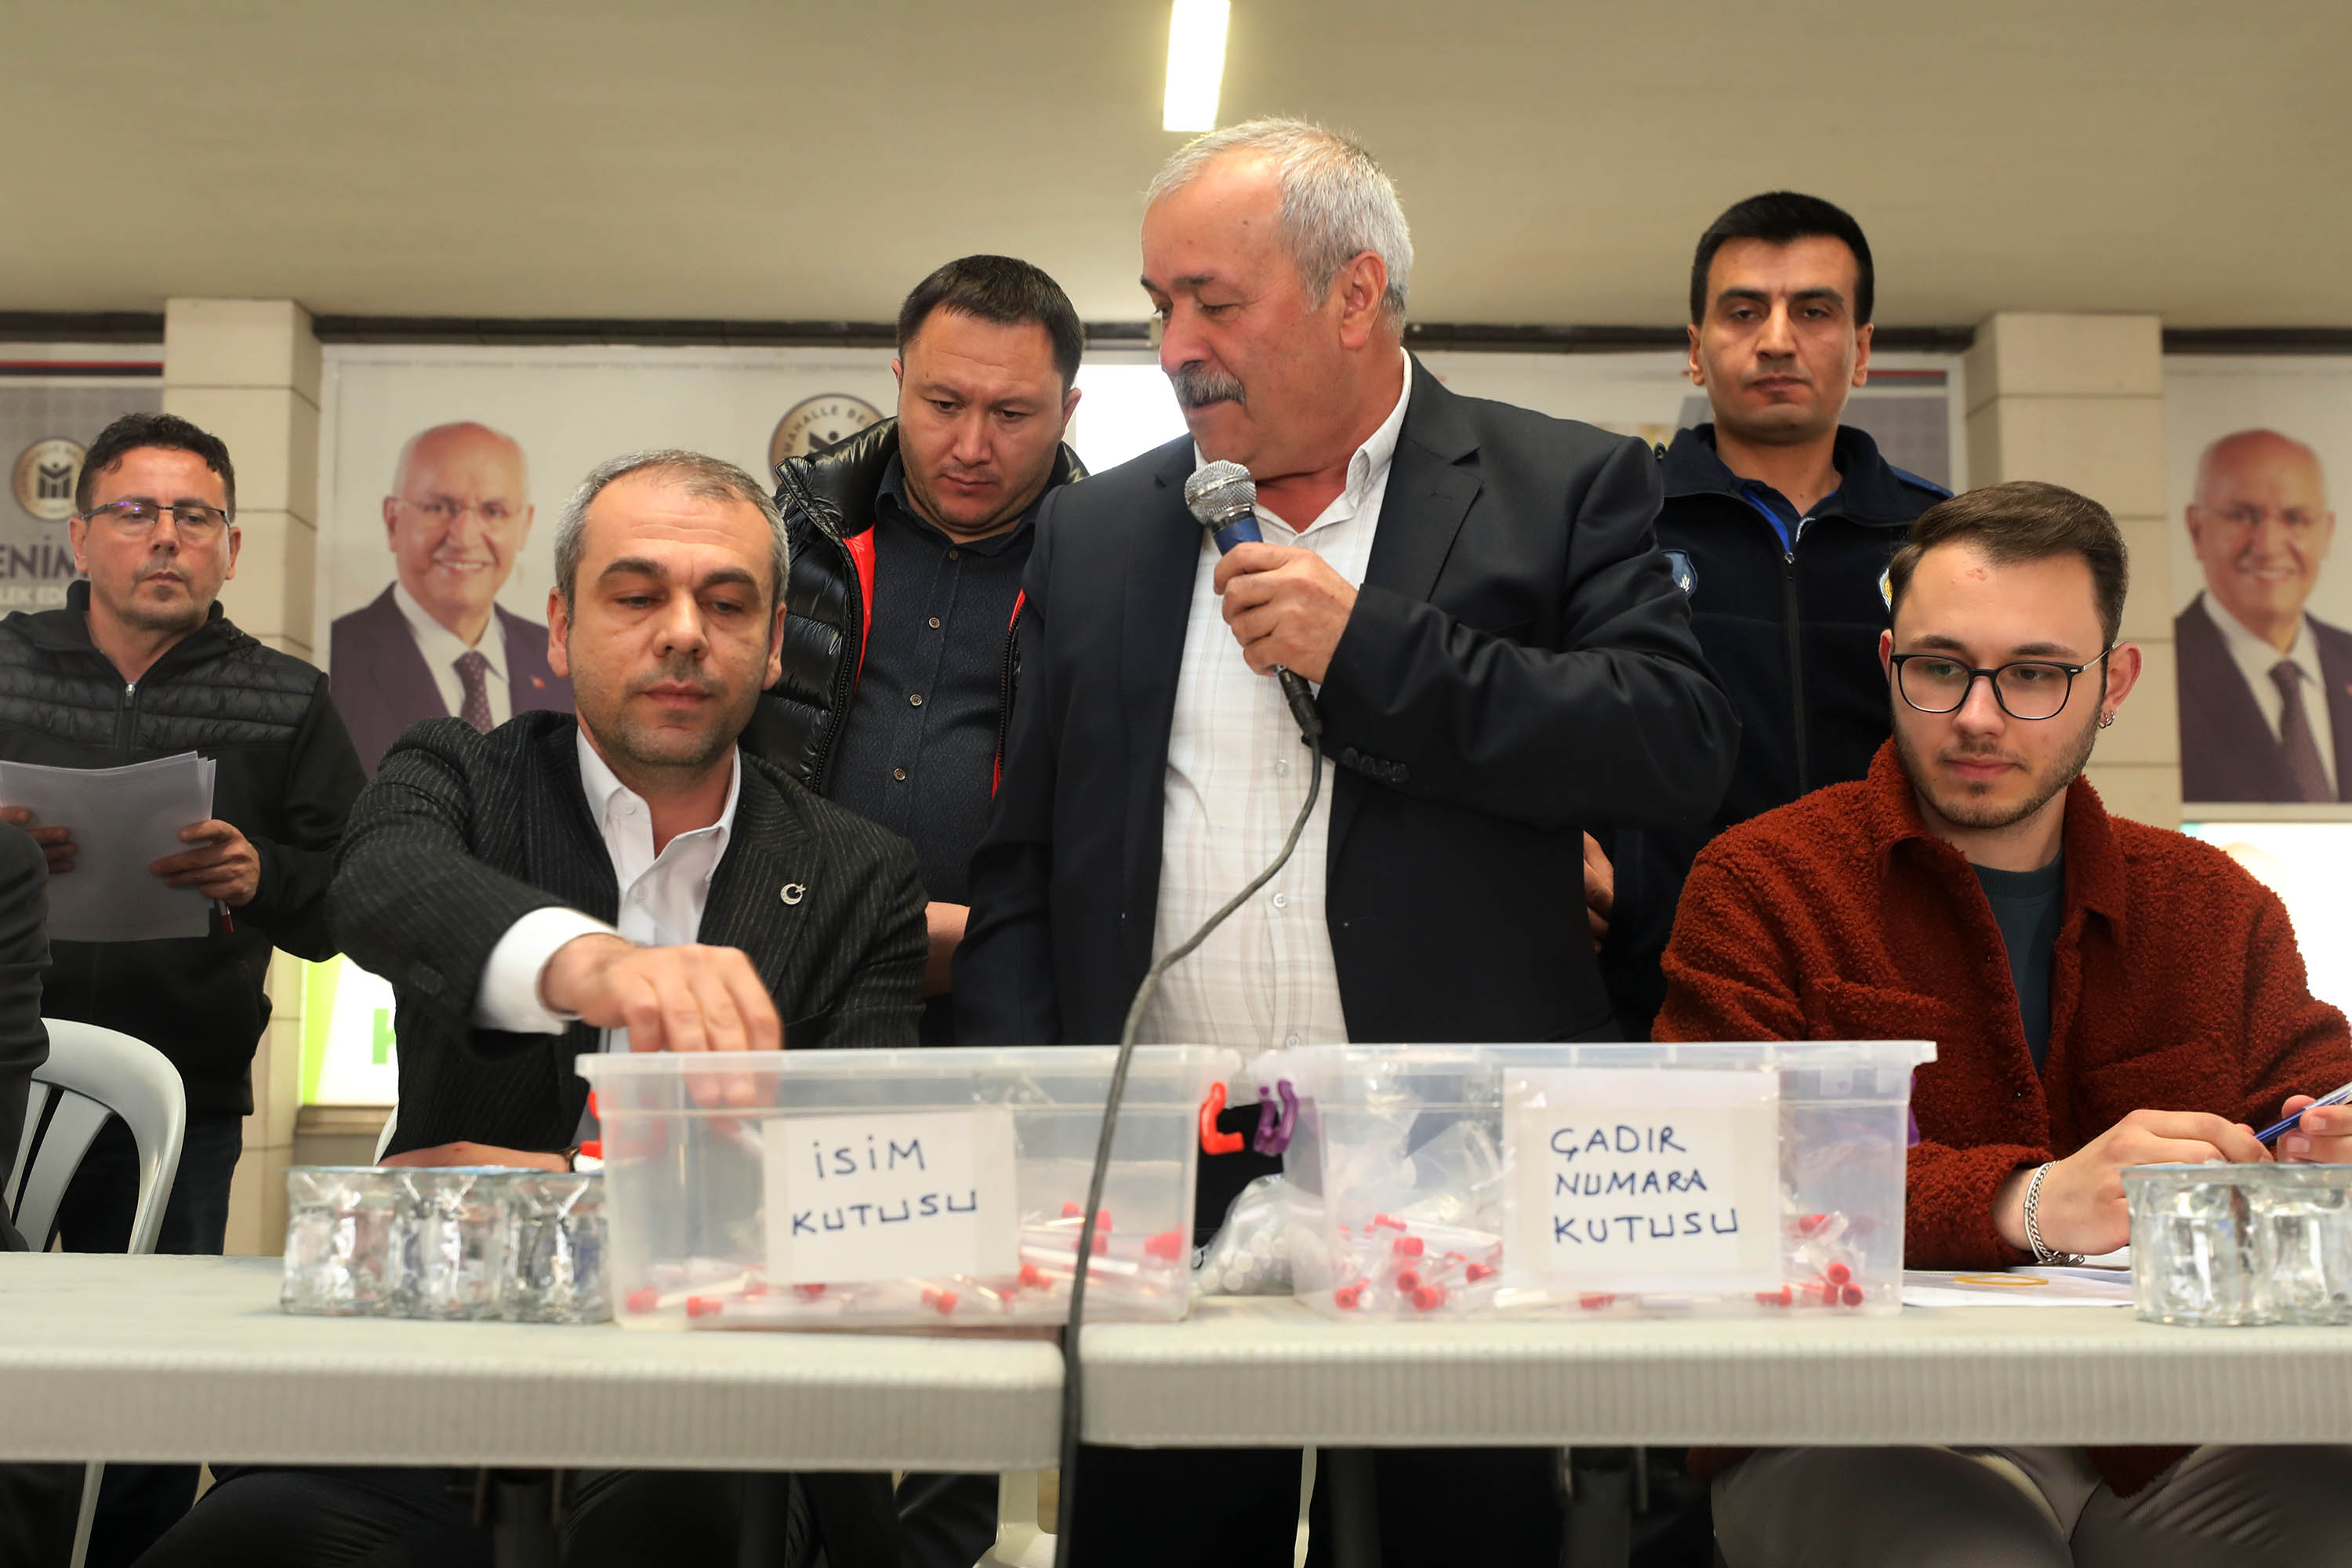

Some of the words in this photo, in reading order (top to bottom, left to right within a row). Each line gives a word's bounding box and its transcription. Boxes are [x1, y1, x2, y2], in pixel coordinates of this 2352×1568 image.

[813, 1134, 927, 1179] İSİM
[1550, 1124, 1687, 1162] ÇADIR
[1555, 1168, 1708, 1196] NUMARA
[792, 1189, 978, 1236] KUTUSU
[1553, 1207, 1738, 1243] KUTUSU
